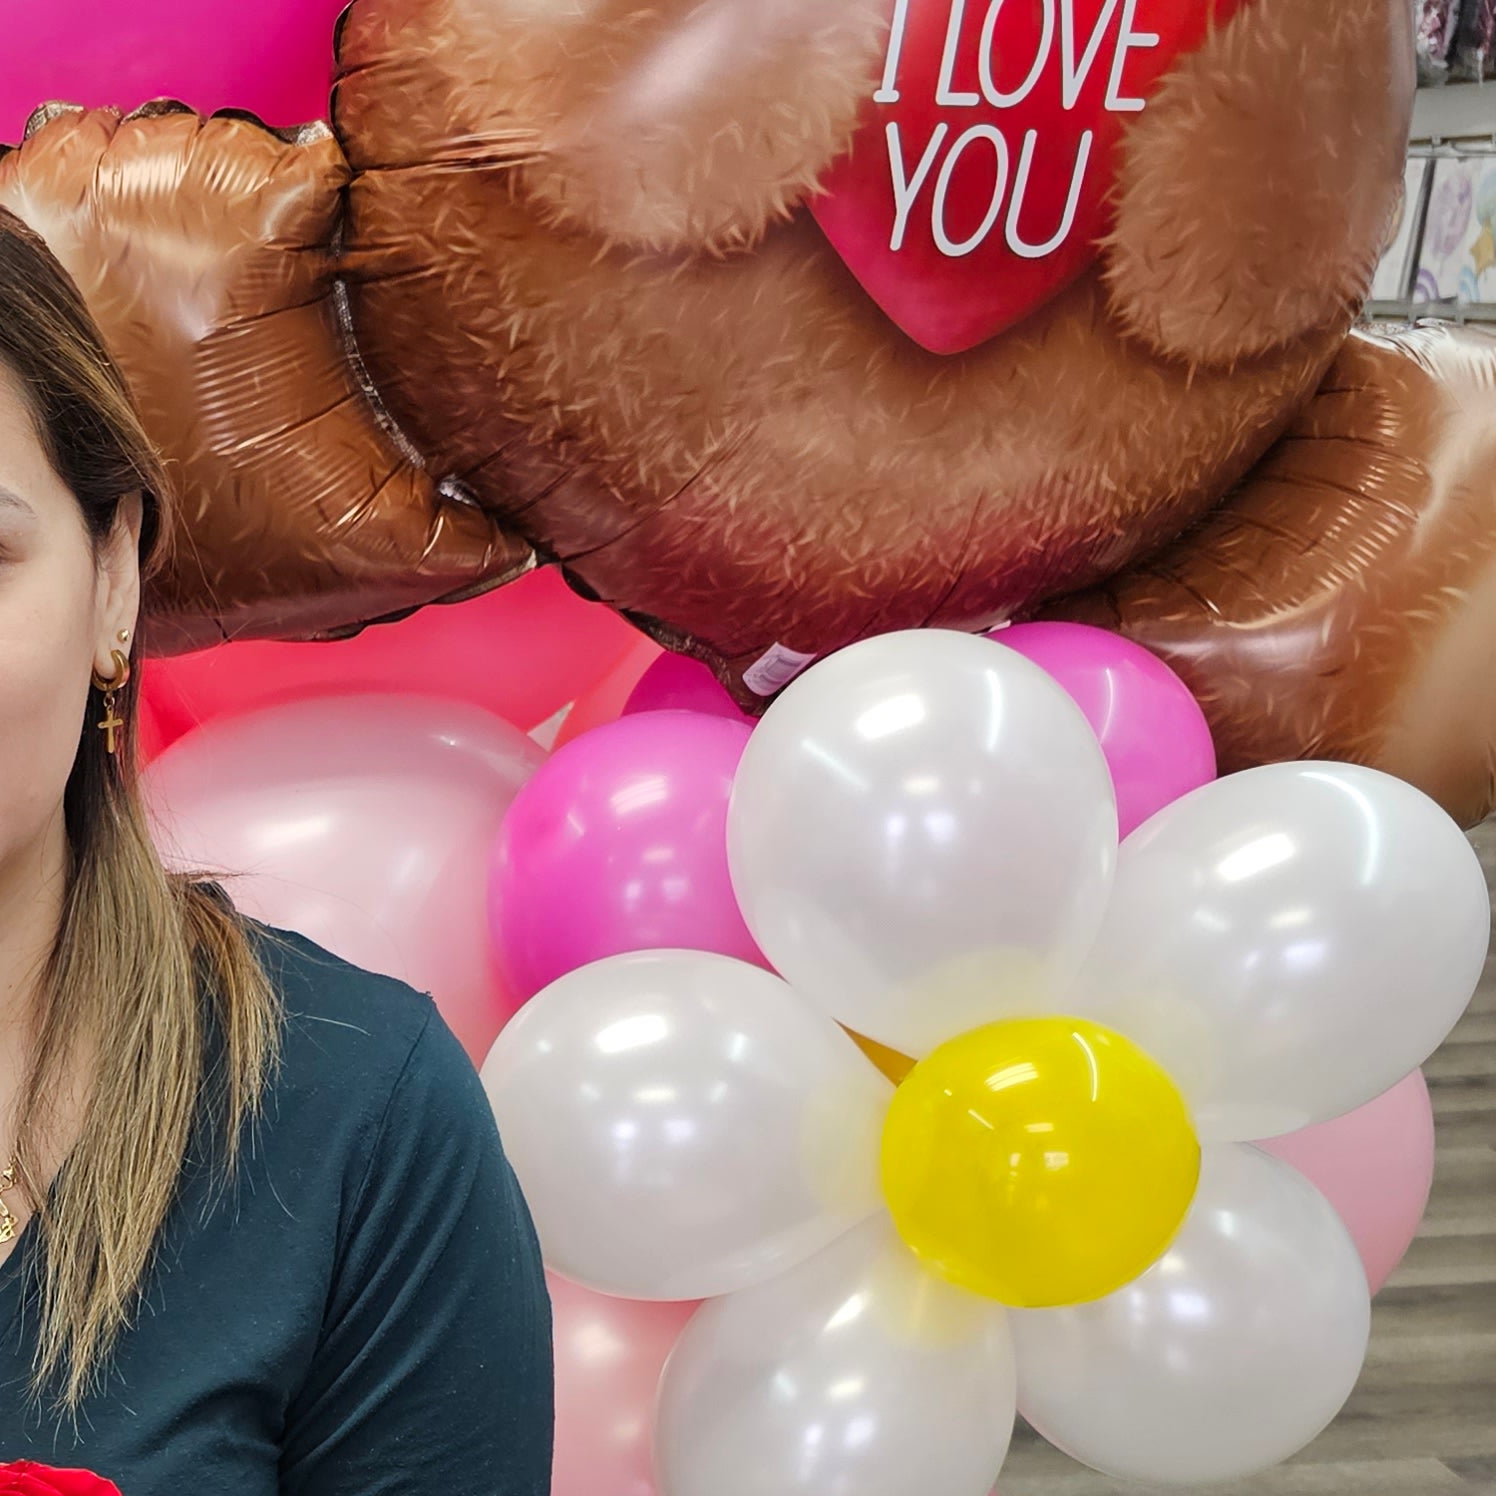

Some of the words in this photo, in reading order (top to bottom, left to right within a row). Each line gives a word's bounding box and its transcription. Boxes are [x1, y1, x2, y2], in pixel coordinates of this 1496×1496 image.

[872, 0, 909, 103] I
[935, 0, 1161, 112] LOVE
[885, 121, 1093, 258] YOU
